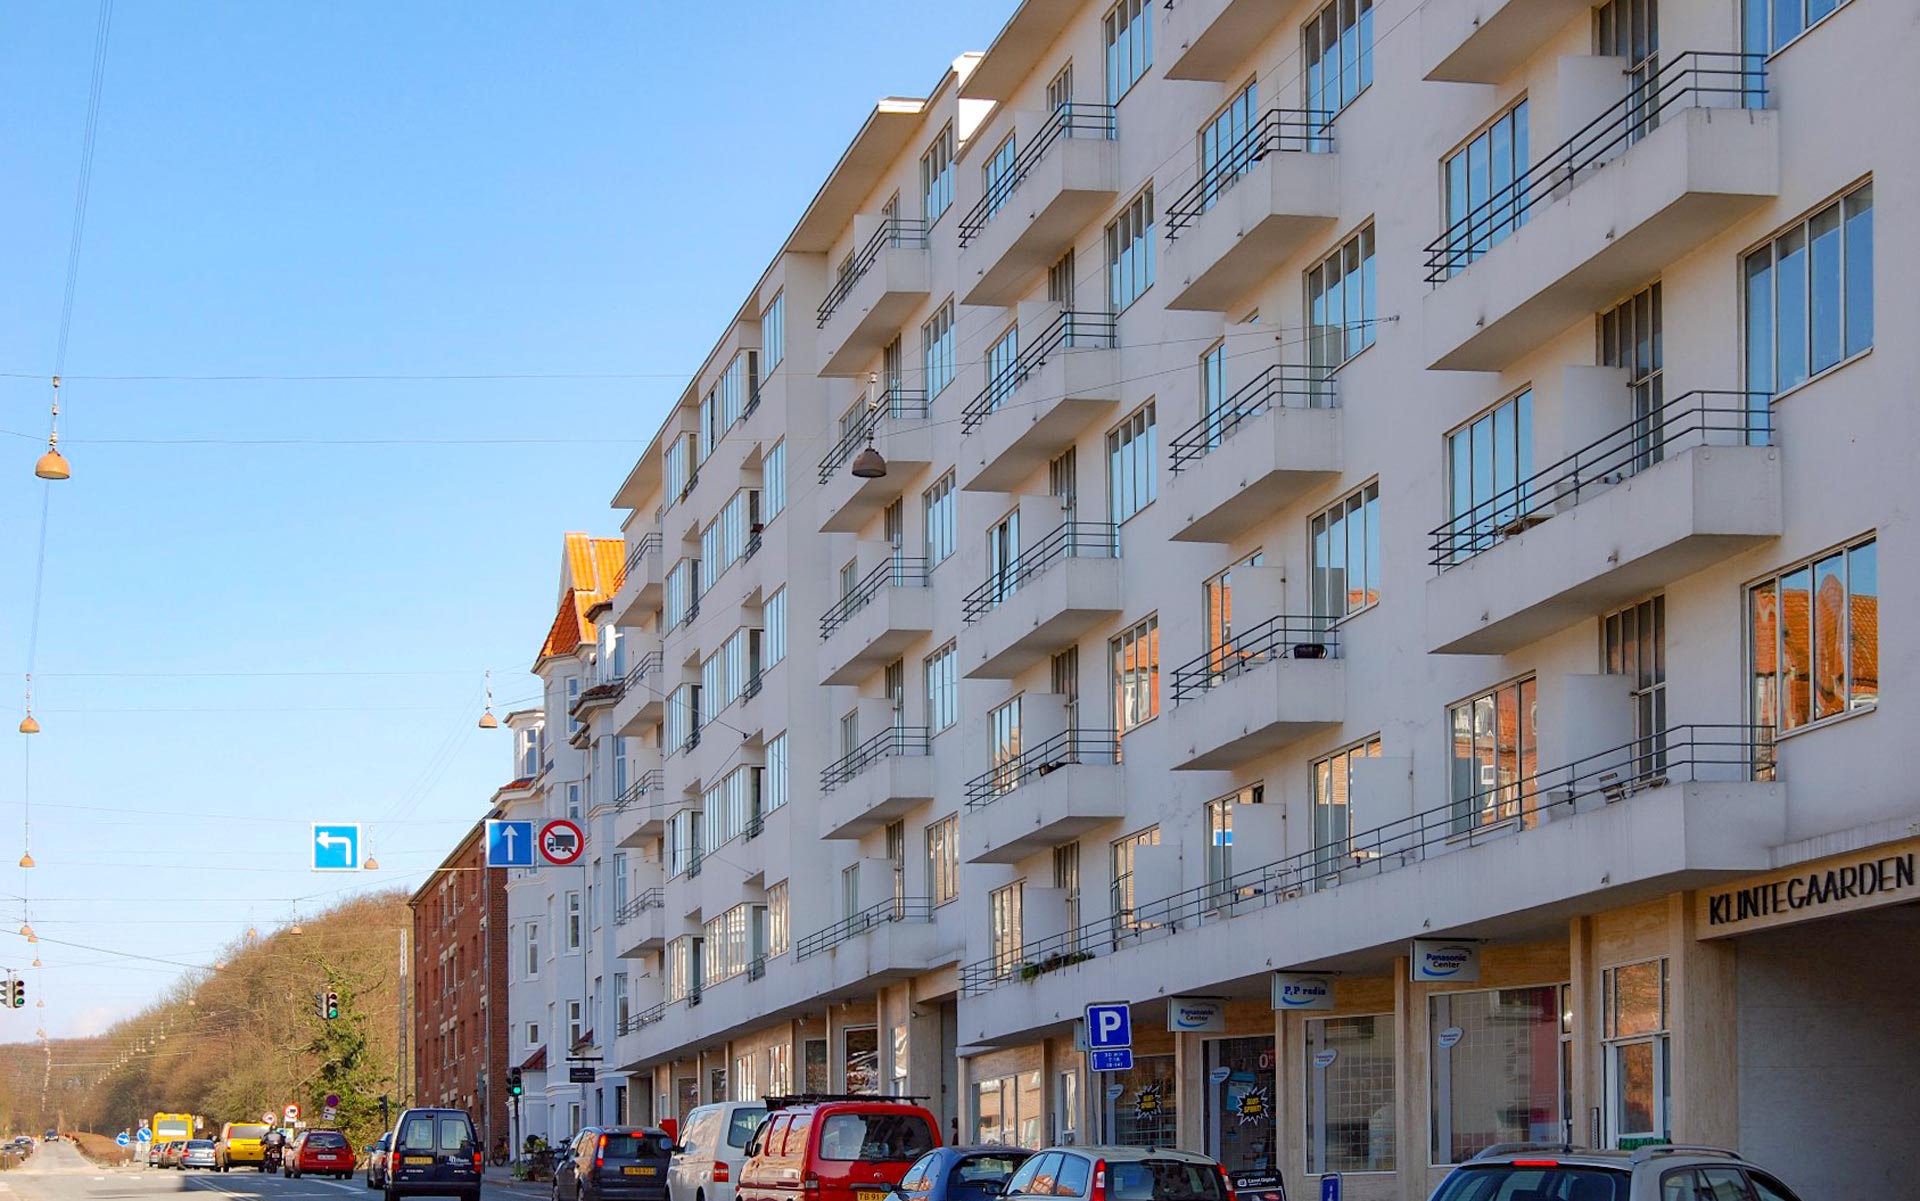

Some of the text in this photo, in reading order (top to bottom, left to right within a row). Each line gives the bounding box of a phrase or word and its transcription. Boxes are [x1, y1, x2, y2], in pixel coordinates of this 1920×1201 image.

[1709, 853, 1915, 926] KLINTEGAARDEN
[1426, 953, 1467, 962] Panasonic
[1432, 961, 1460, 969] Center
[1302, 986, 1326, 996] radio
[1099, 1010, 1121, 1042] P
